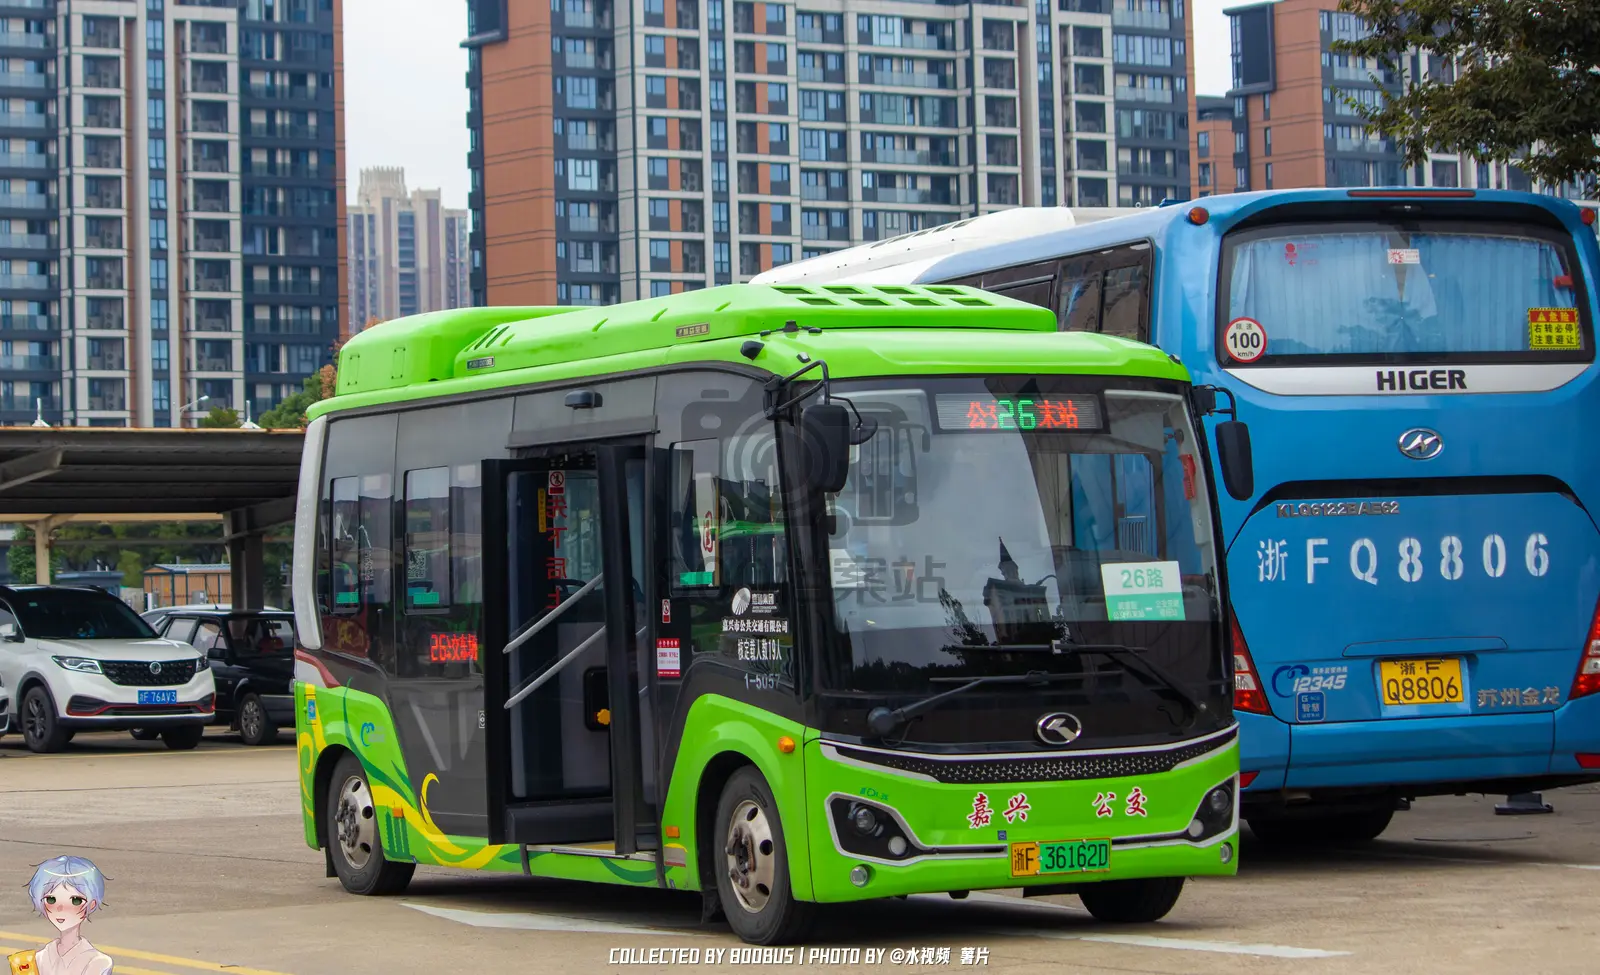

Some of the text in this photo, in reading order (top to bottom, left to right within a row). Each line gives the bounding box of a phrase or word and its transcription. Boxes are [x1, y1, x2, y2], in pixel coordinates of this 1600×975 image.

[1230, 332, 1260, 348] 100
[1376, 369, 1467, 391] HIGER
[1121, 567, 1164, 588] 26路
[722, 618, 788, 633] 嘉兴市公共交通有限公司
[737, 638, 782, 660] 核定载人数19人
[1292, 674, 1348, 692] 12345
[1386, 676, 1459, 703] Q8806
[1477, 686, 1560, 708] 苏州金龙
[967, 787, 1148, 829] 嘉兴 公交
